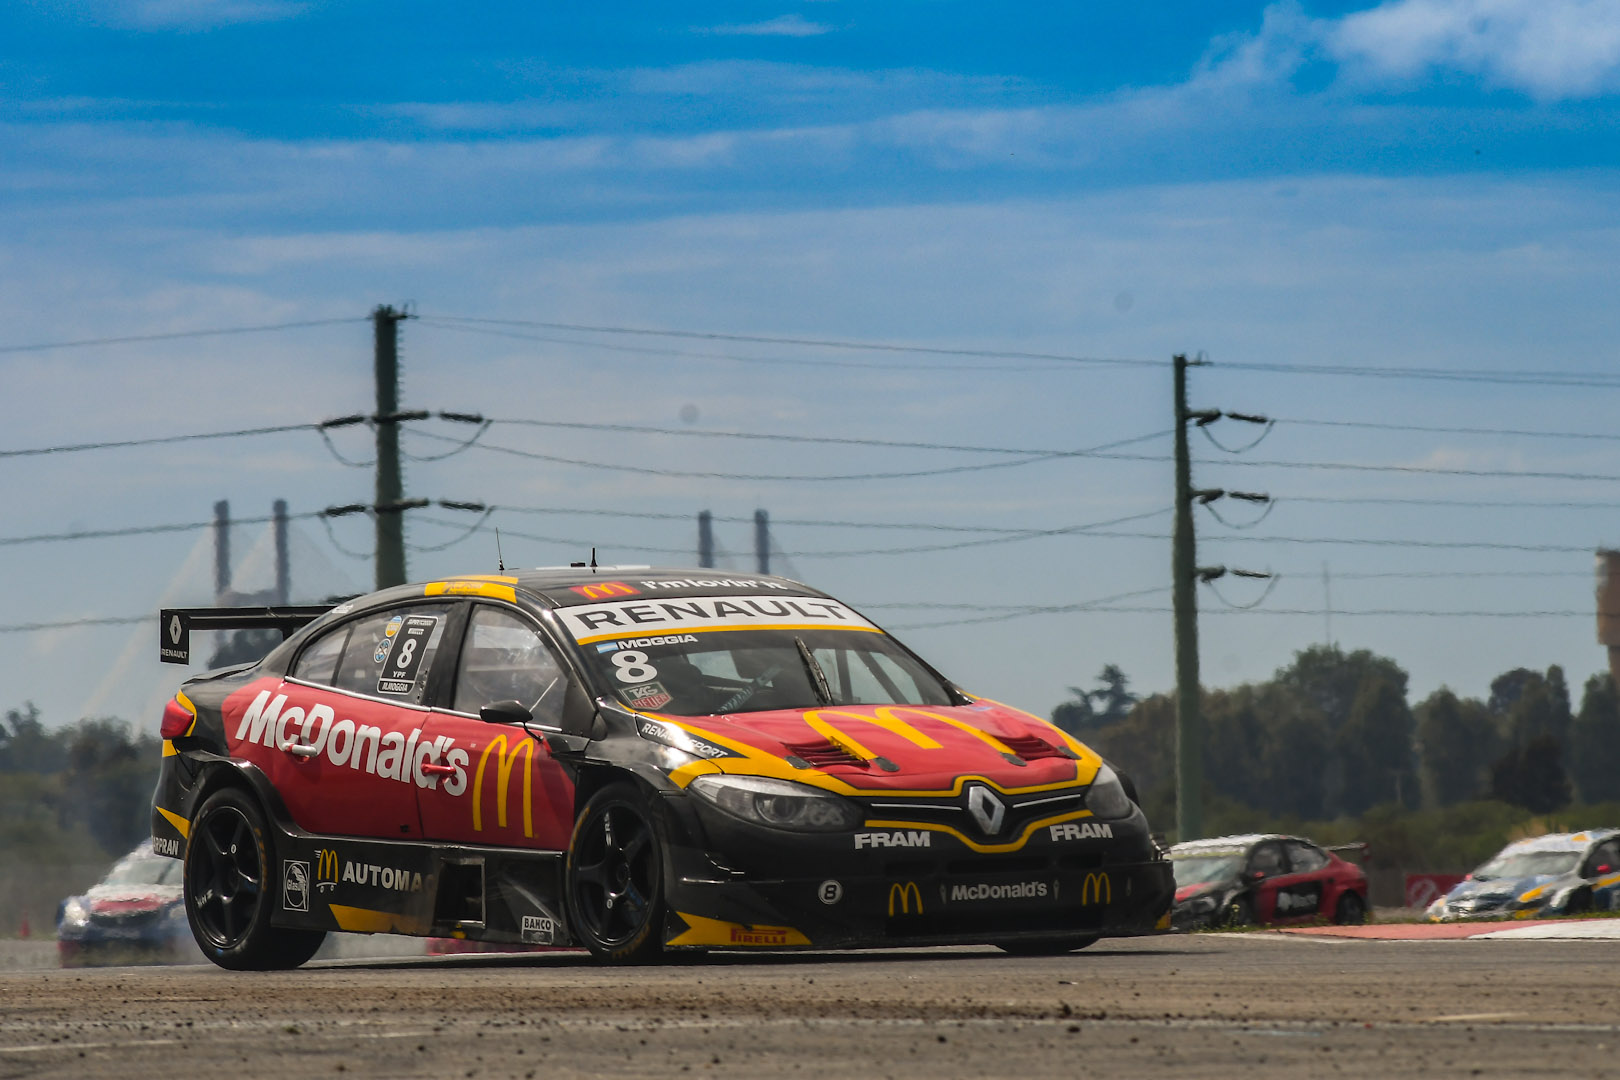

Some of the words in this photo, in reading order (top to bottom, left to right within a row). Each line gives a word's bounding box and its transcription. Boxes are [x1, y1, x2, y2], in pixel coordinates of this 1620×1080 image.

[574, 599, 848, 631] RENAULT
[617, 633, 699, 650] MOGGIA
[161, 648, 188, 659] RENAULT
[397, 638, 417, 669] 8
[393, 670, 407, 679] YPF
[611, 650, 658, 684] 8
[629, 685, 659, 699] TAG
[631, 693, 672, 709] HEUER
[235, 690, 469, 797] McDonald's
[854, 830, 931, 849] FRAM
[1050, 822, 1114, 842] FRAM
[824, 884, 837, 900] 8
[951, 881, 1048, 901] McDonald's
[524, 917, 552, 931] BAHCO
[730, 927, 788, 945] PIRELLI
